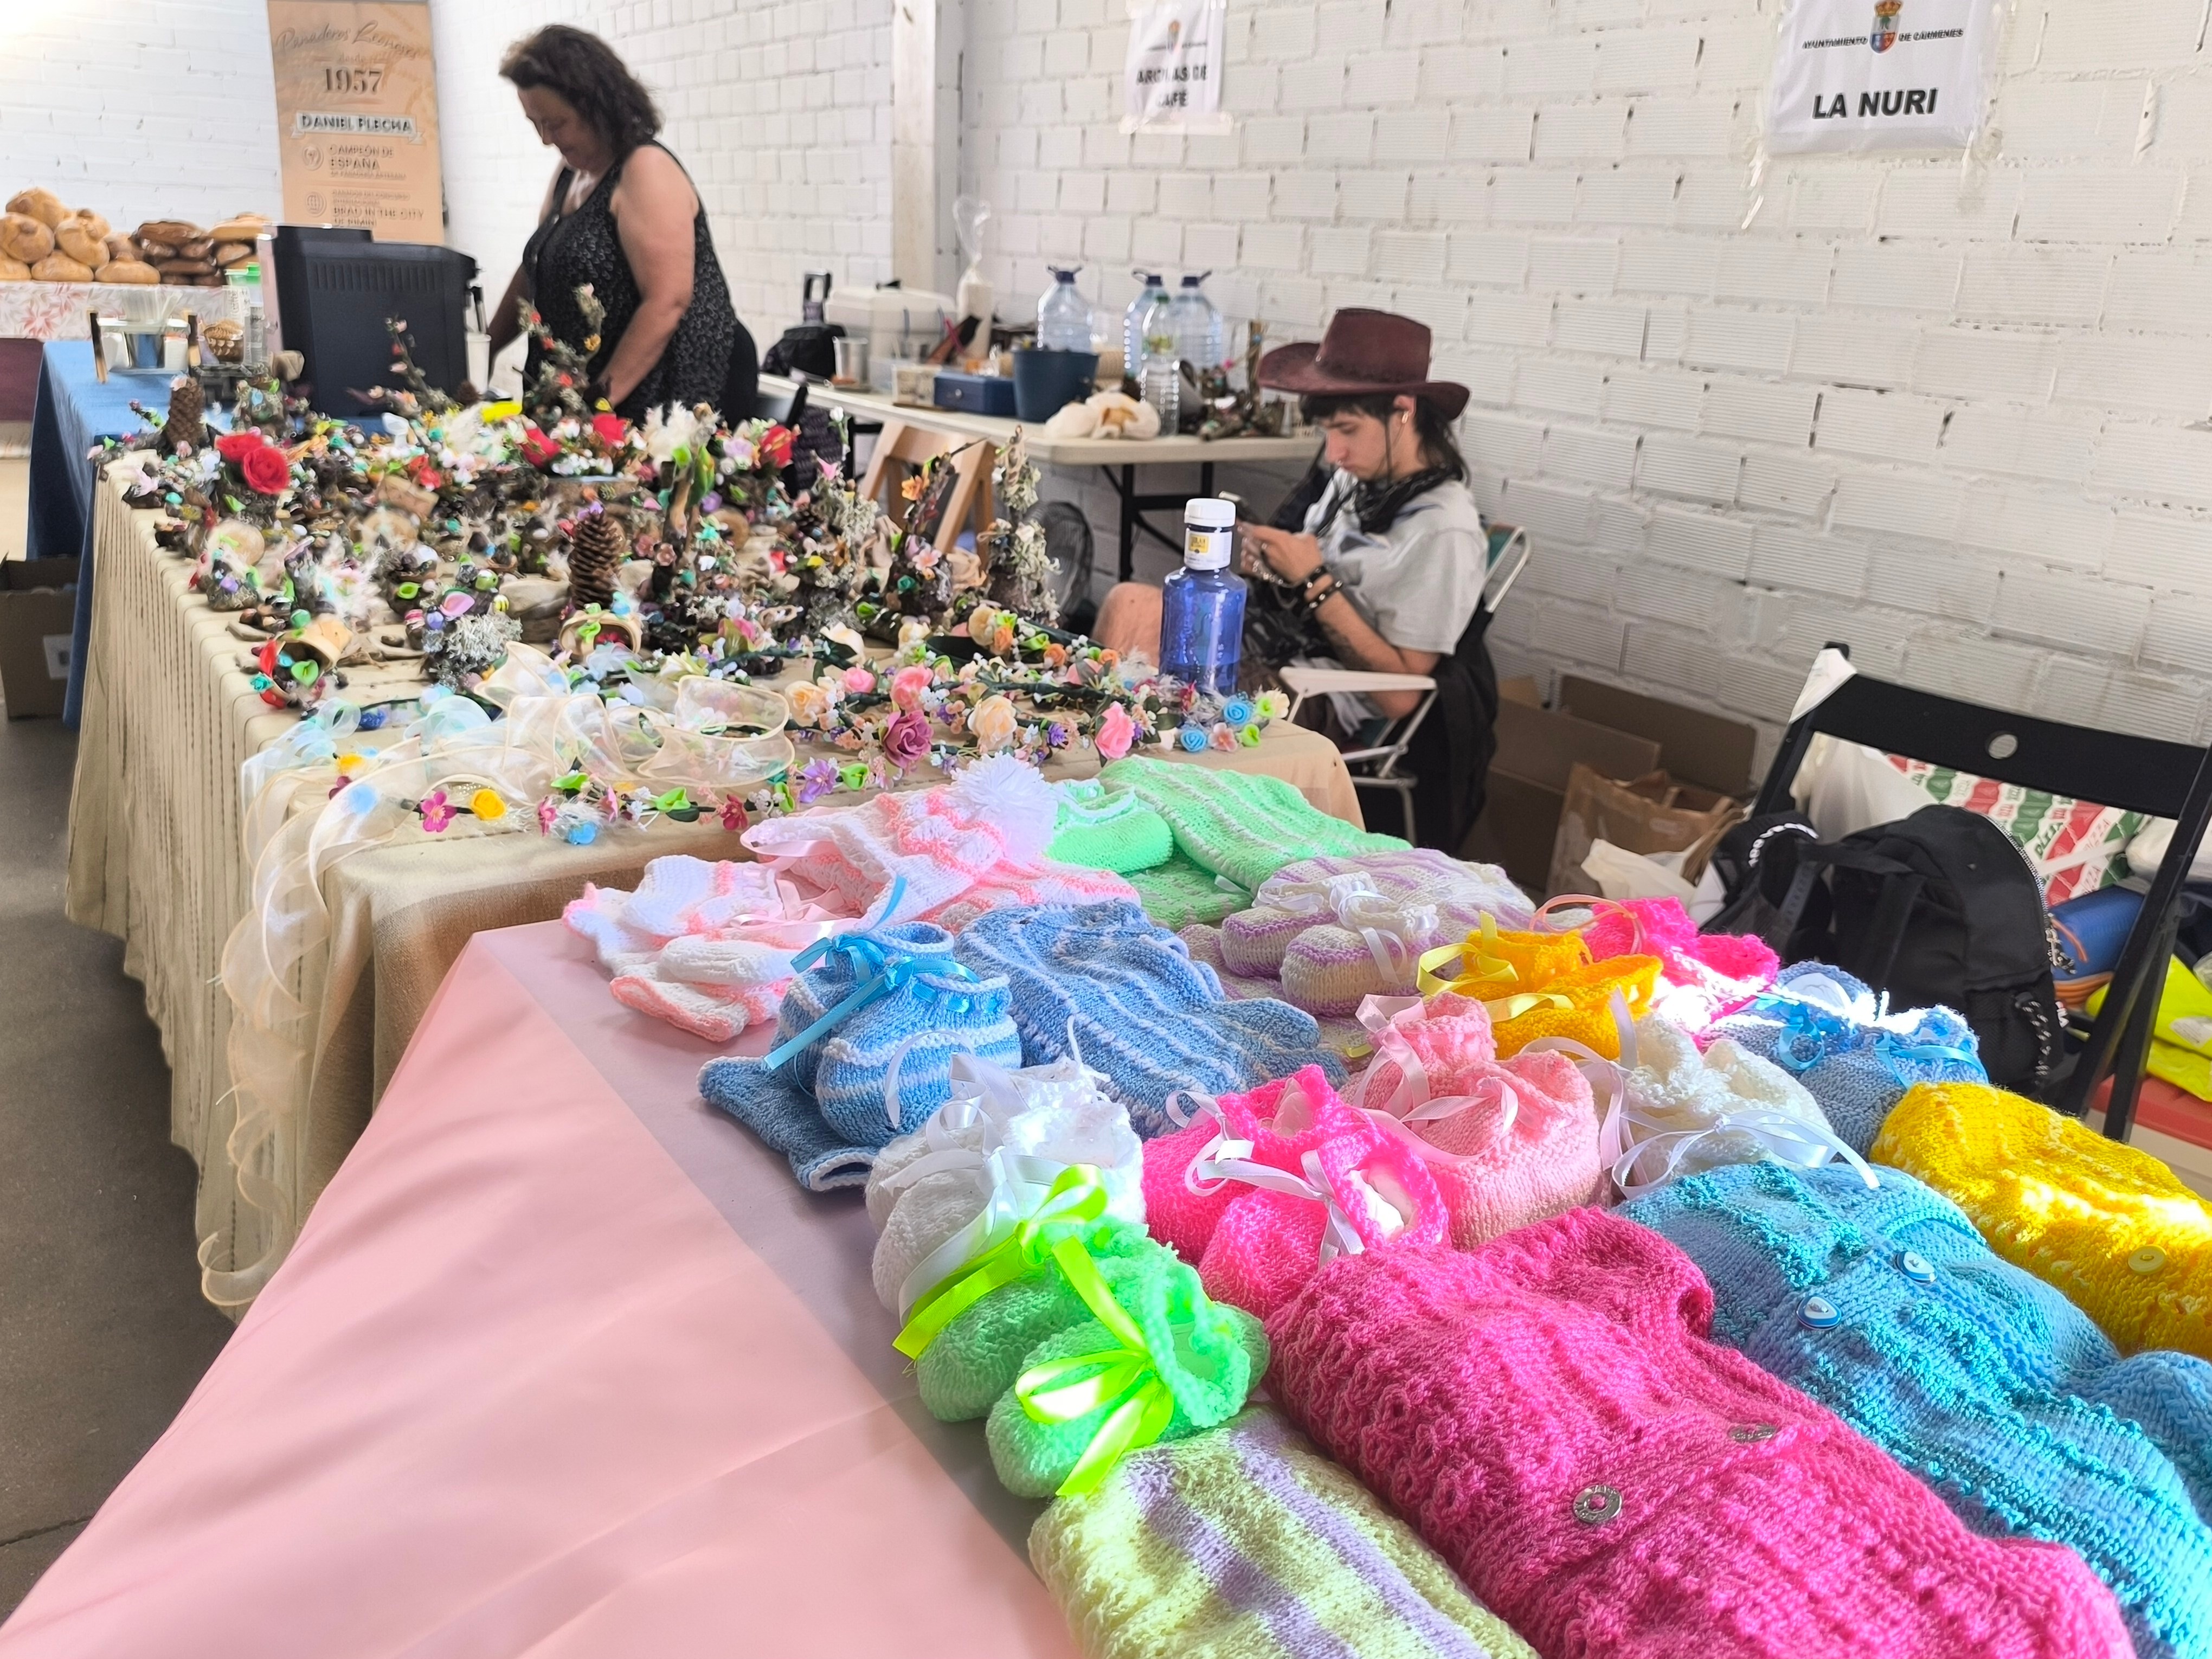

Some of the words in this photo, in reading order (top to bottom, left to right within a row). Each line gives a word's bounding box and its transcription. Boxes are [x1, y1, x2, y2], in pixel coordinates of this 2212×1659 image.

[1802, 35, 1868, 49] AYUNTAMIENTO
[1899, 33, 1912, 42] DE
[326, 67, 382, 94] 1957
[1812, 92, 1848, 119] LA
[1857, 87, 1939, 118] NURI
[301, 114, 353, 130] DANIEL
[382, 146, 395, 158] DE
[329, 156, 380, 170] ESPAÑA
